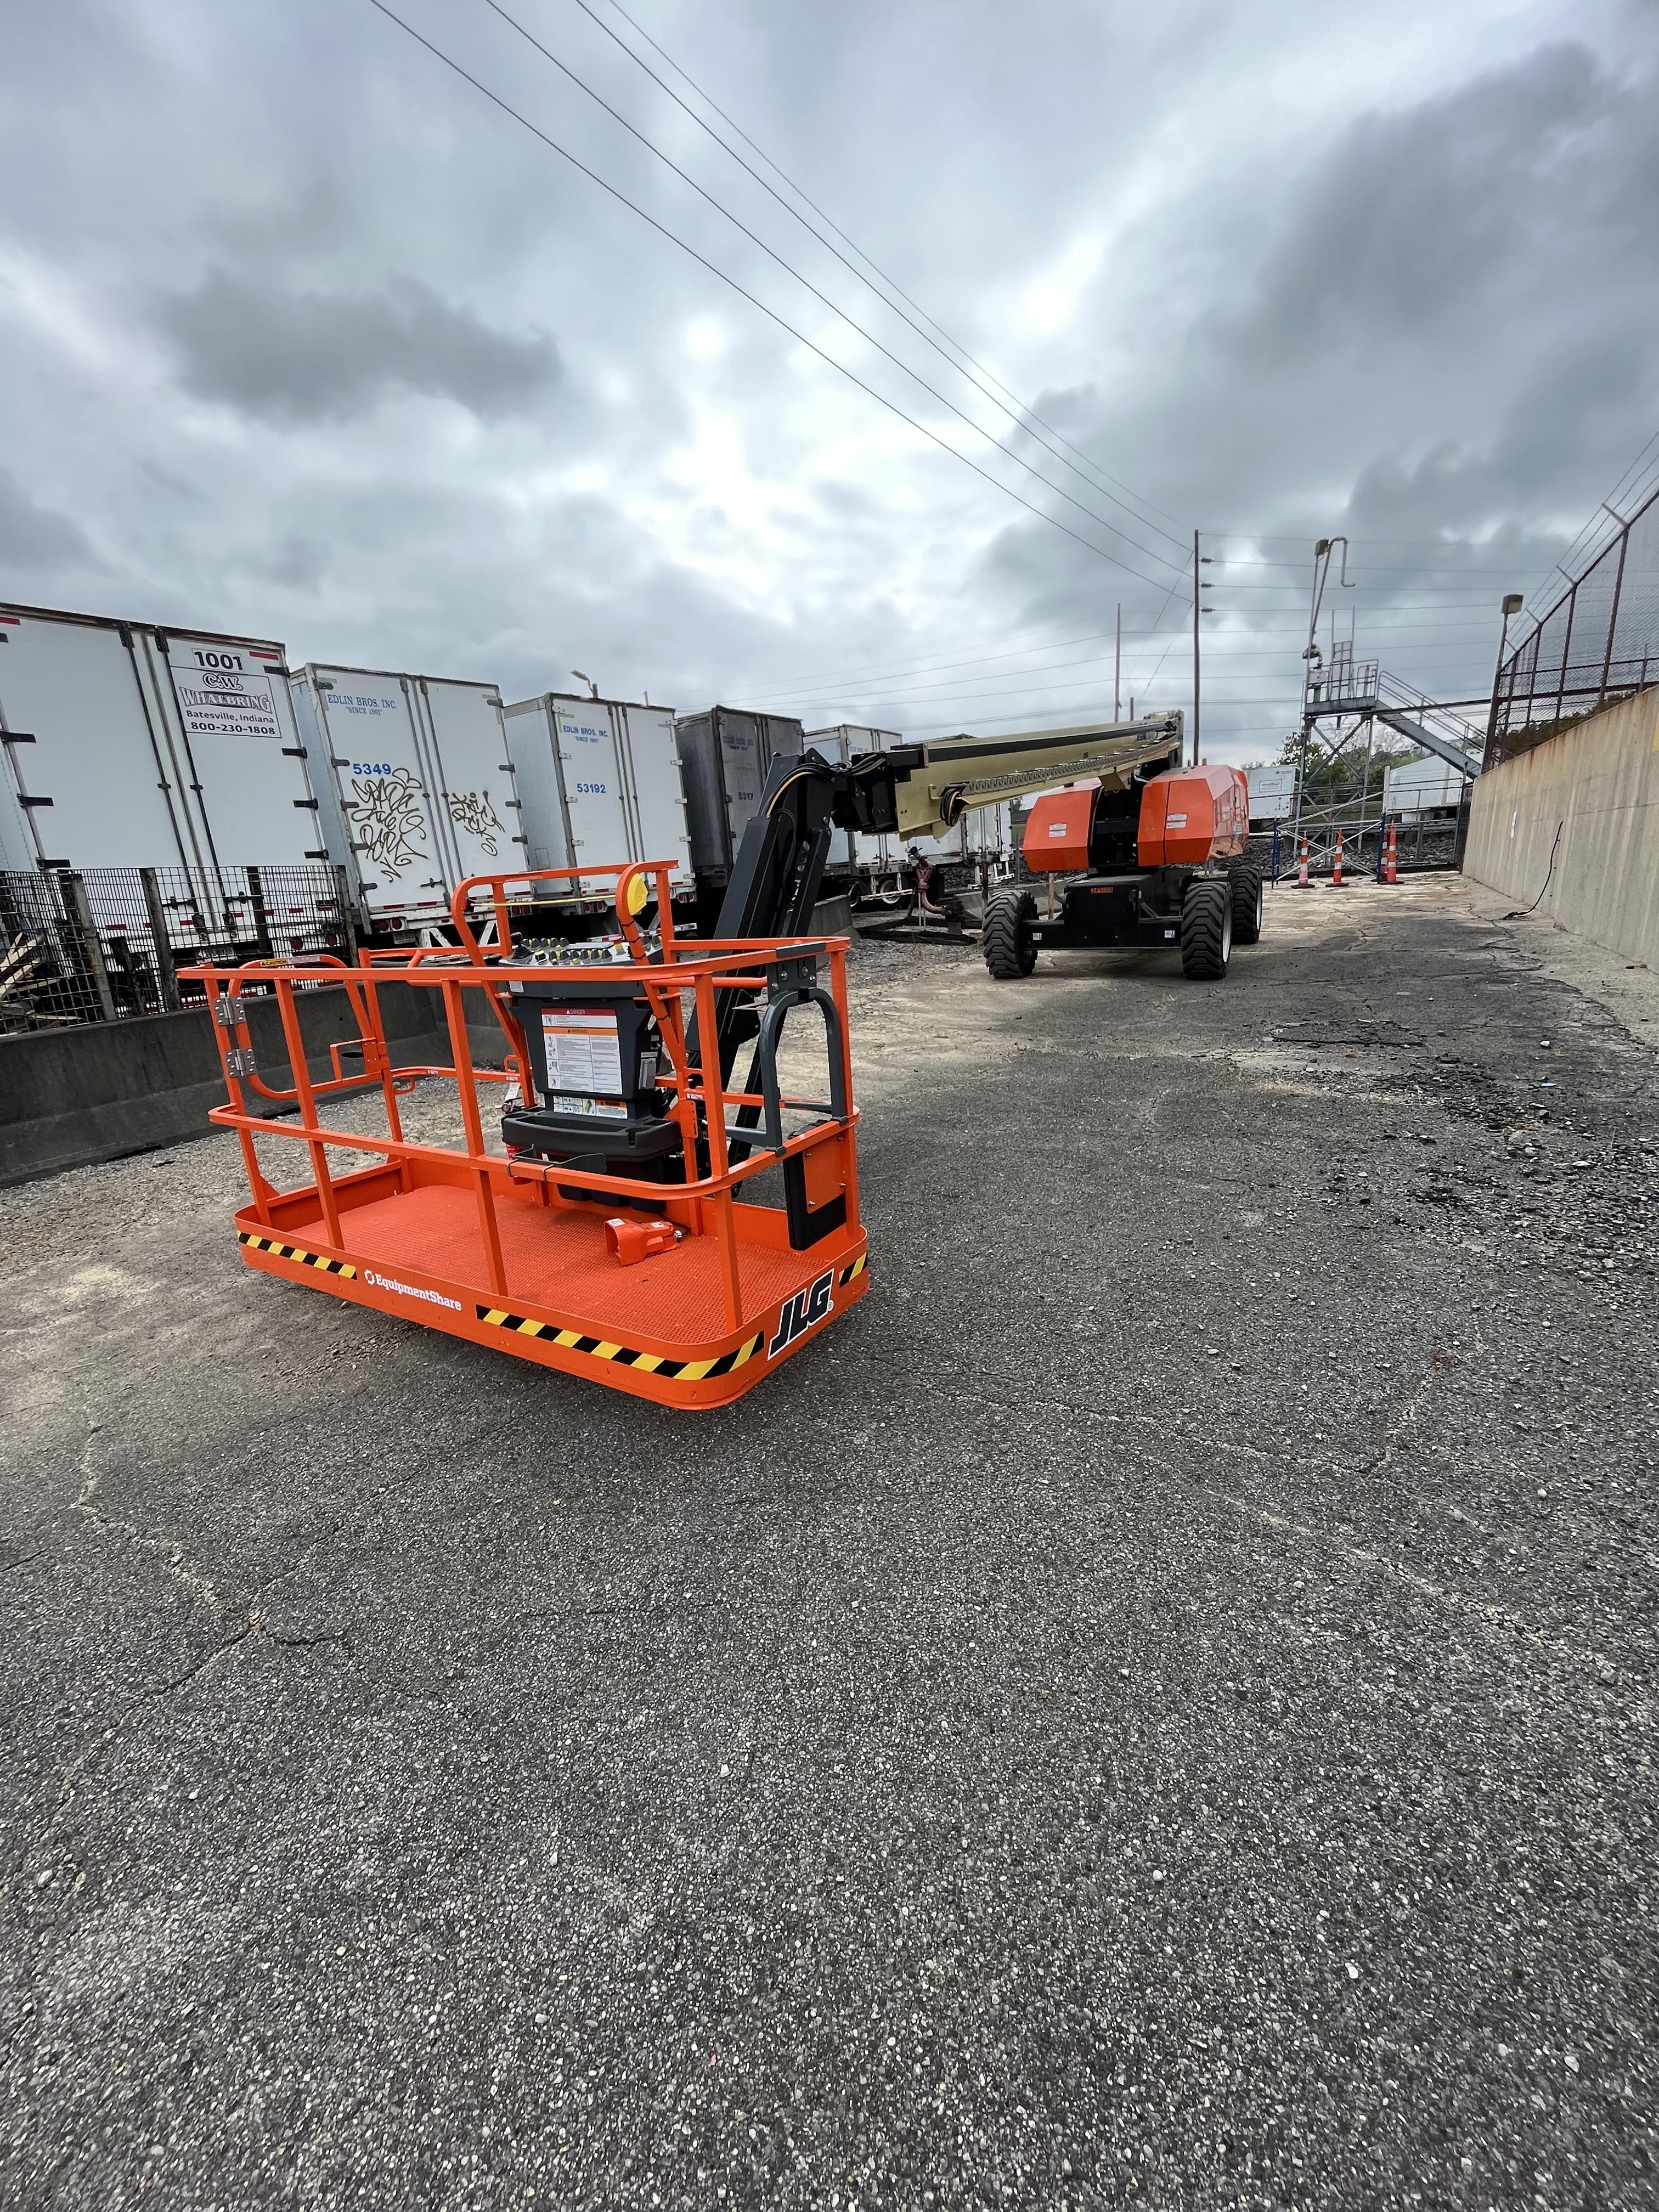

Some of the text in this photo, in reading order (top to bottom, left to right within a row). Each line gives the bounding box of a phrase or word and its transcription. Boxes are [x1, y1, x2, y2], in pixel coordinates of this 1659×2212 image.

[194, 651, 243, 670] 1001
[179, 686, 273, 714] WHALBRING
[327, 695, 353, 706] EDLIN
[356, 697, 379, 708] BROS.
[187, 710, 274, 723] Batesville, Indiana
[191, 722, 275, 735] 800-230-1808
[563, 725, 579, 734] EDLIN
[580, 727, 597, 736] BROS.
[353, 763, 391, 775] 5349
[577, 783, 606, 794] 53192
[738, 792, 753, 800] 5317
[375, 1273, 462, 1311] EquipmentShare
[767, 1267, 835, 1361] JLG
